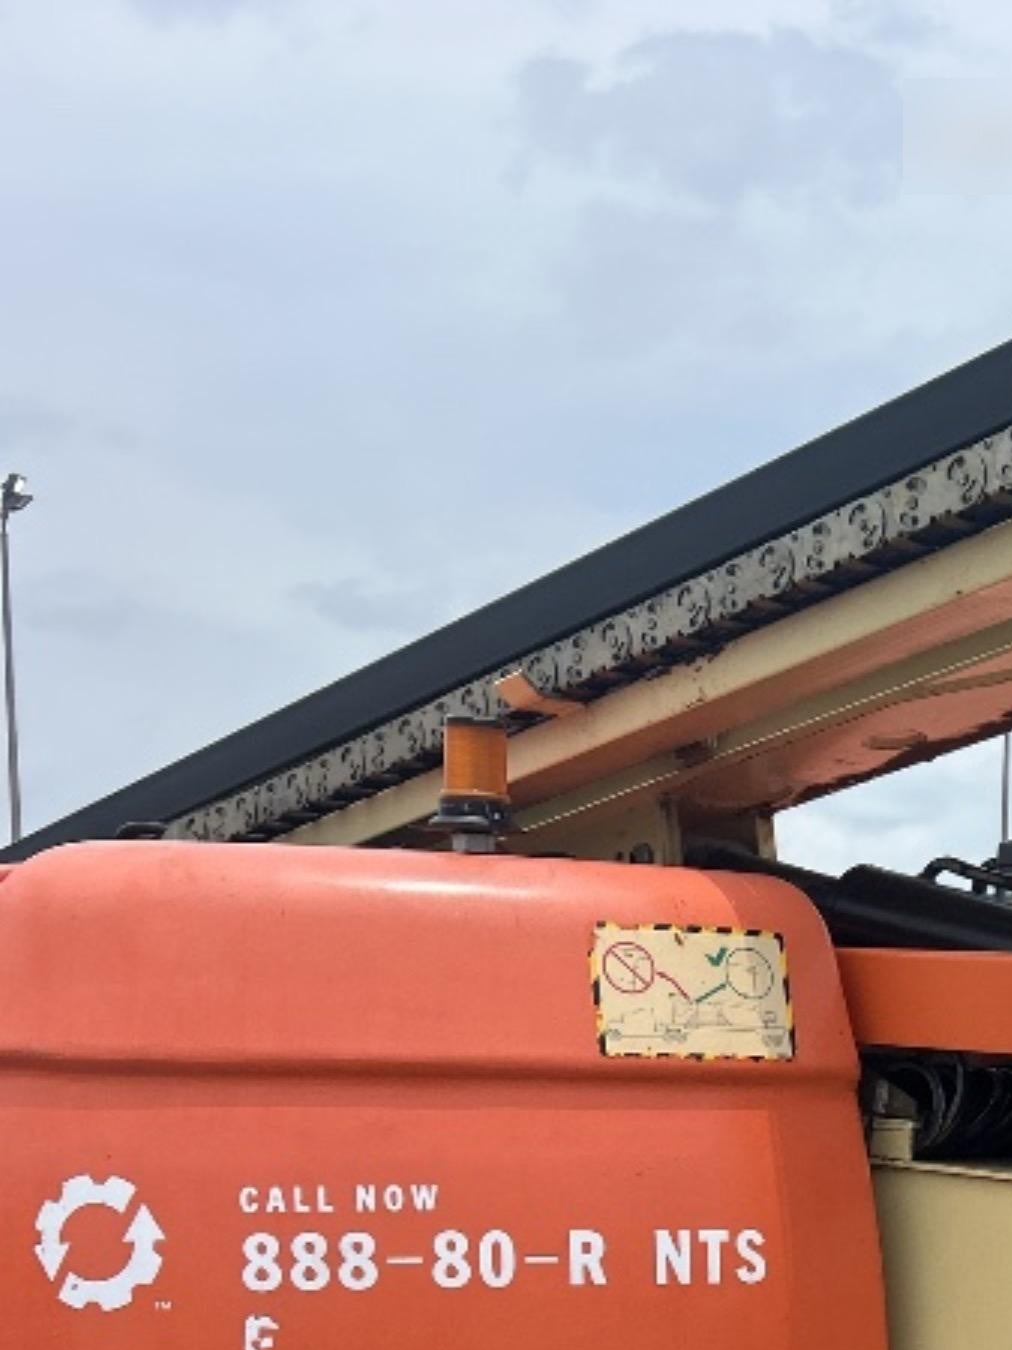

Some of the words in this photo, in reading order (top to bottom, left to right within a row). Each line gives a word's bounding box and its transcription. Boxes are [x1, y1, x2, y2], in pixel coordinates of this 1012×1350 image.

[239, 1185, 334, 1213] CALL
[355, 1183, 439, 1212] NOW
[653, 1228, 768, 1285] NTS
